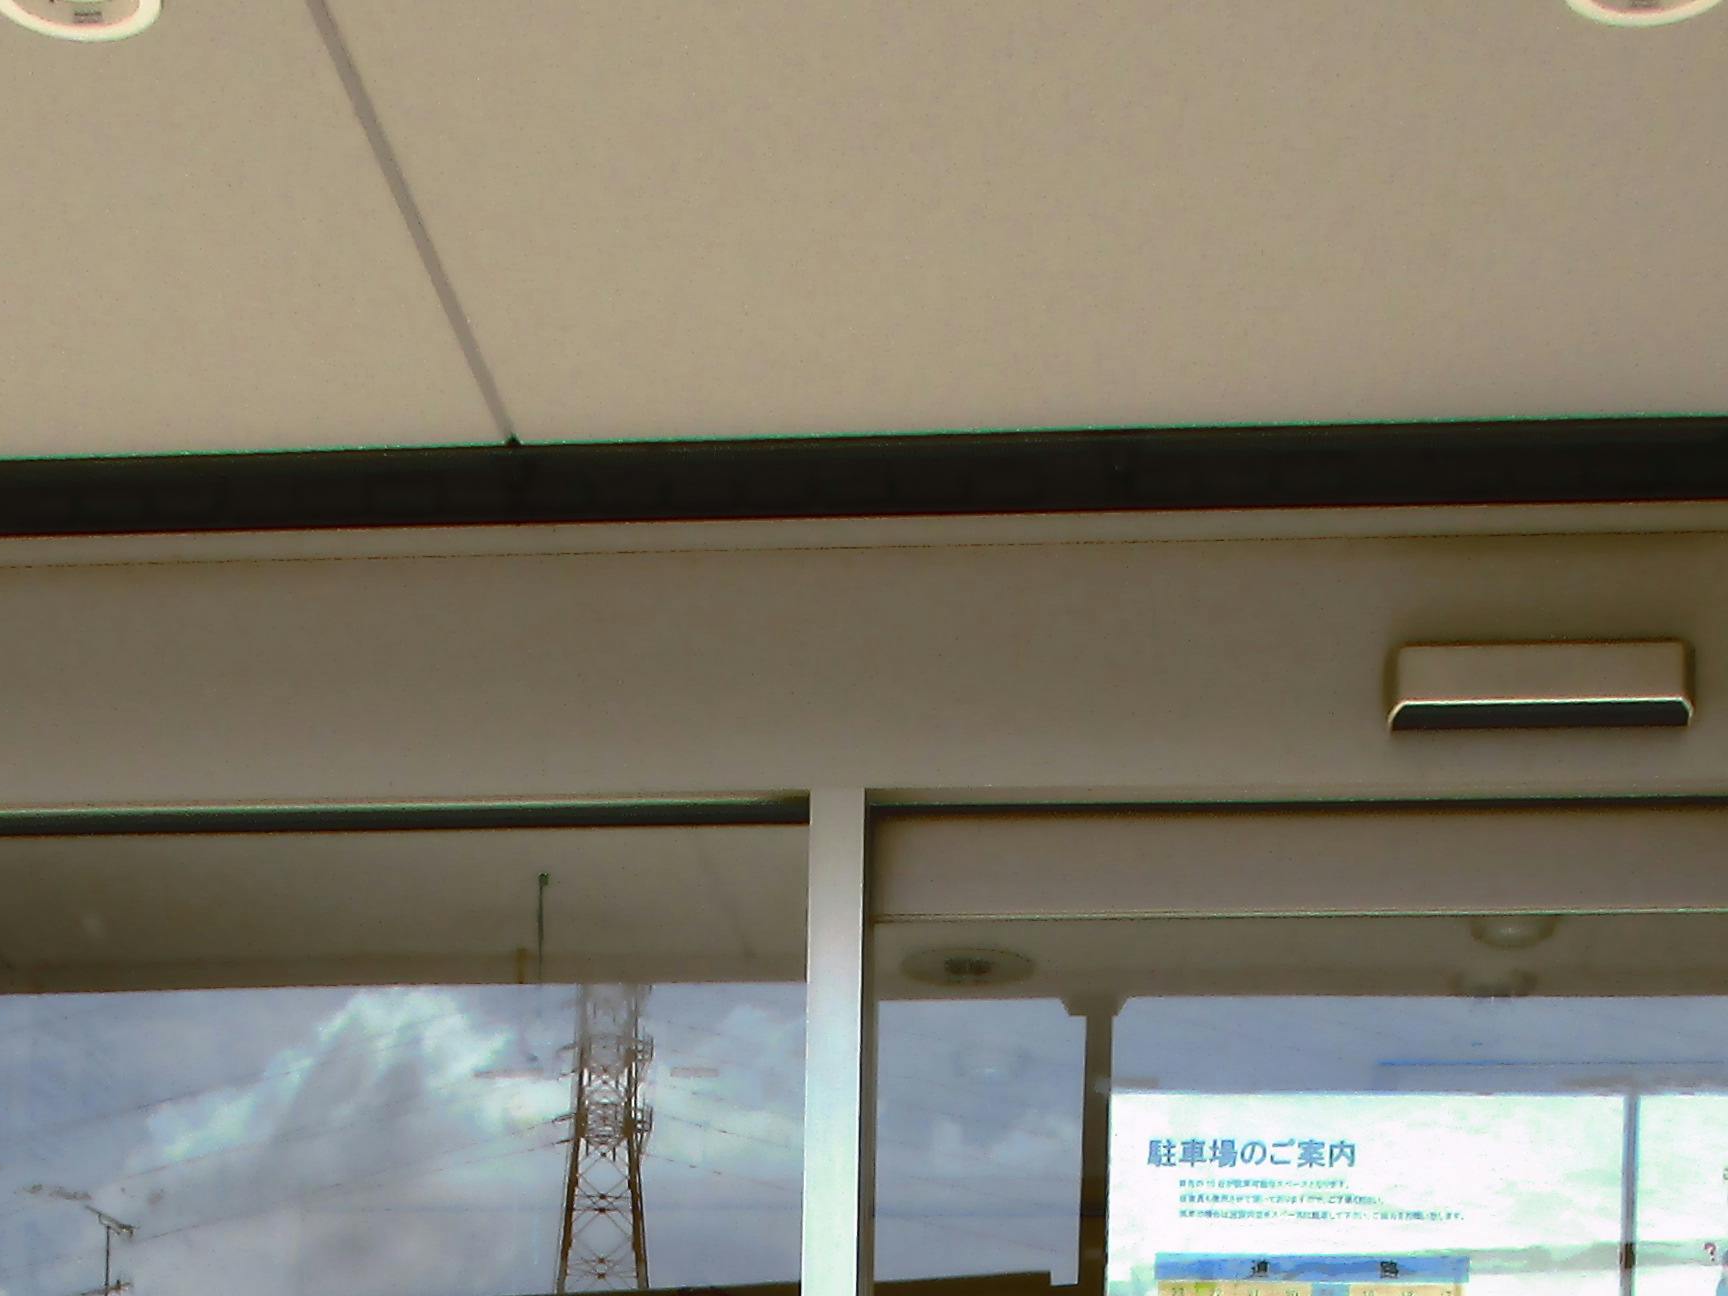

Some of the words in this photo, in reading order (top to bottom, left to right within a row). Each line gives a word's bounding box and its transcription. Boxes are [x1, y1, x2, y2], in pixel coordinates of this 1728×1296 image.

[1147, 1138, 1358, 1169] 駐車場のご案内
